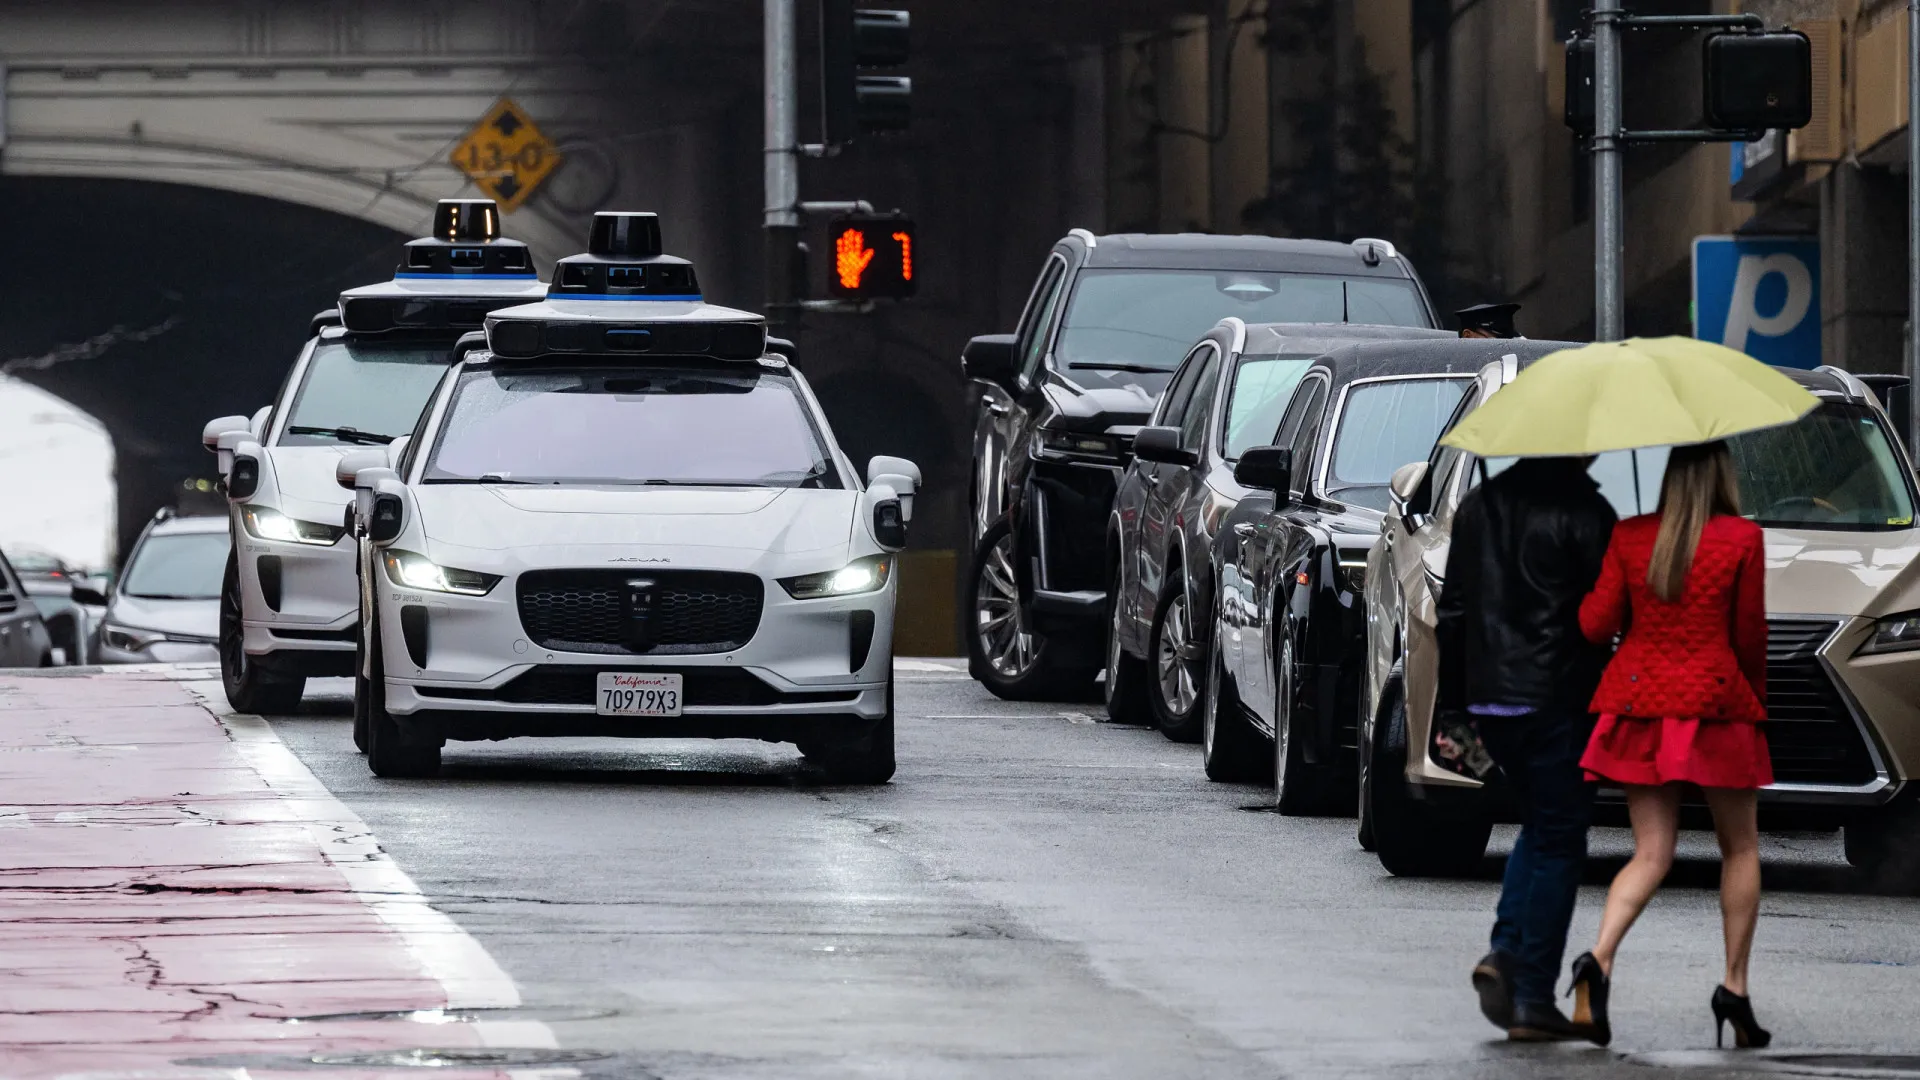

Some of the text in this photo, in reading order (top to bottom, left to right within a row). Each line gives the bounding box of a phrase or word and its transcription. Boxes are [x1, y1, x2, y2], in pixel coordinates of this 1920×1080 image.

[892, 231, 912, 280] 7
[615, 675, 667, 688] California
[603, 689, 677, 710] 70979X3
